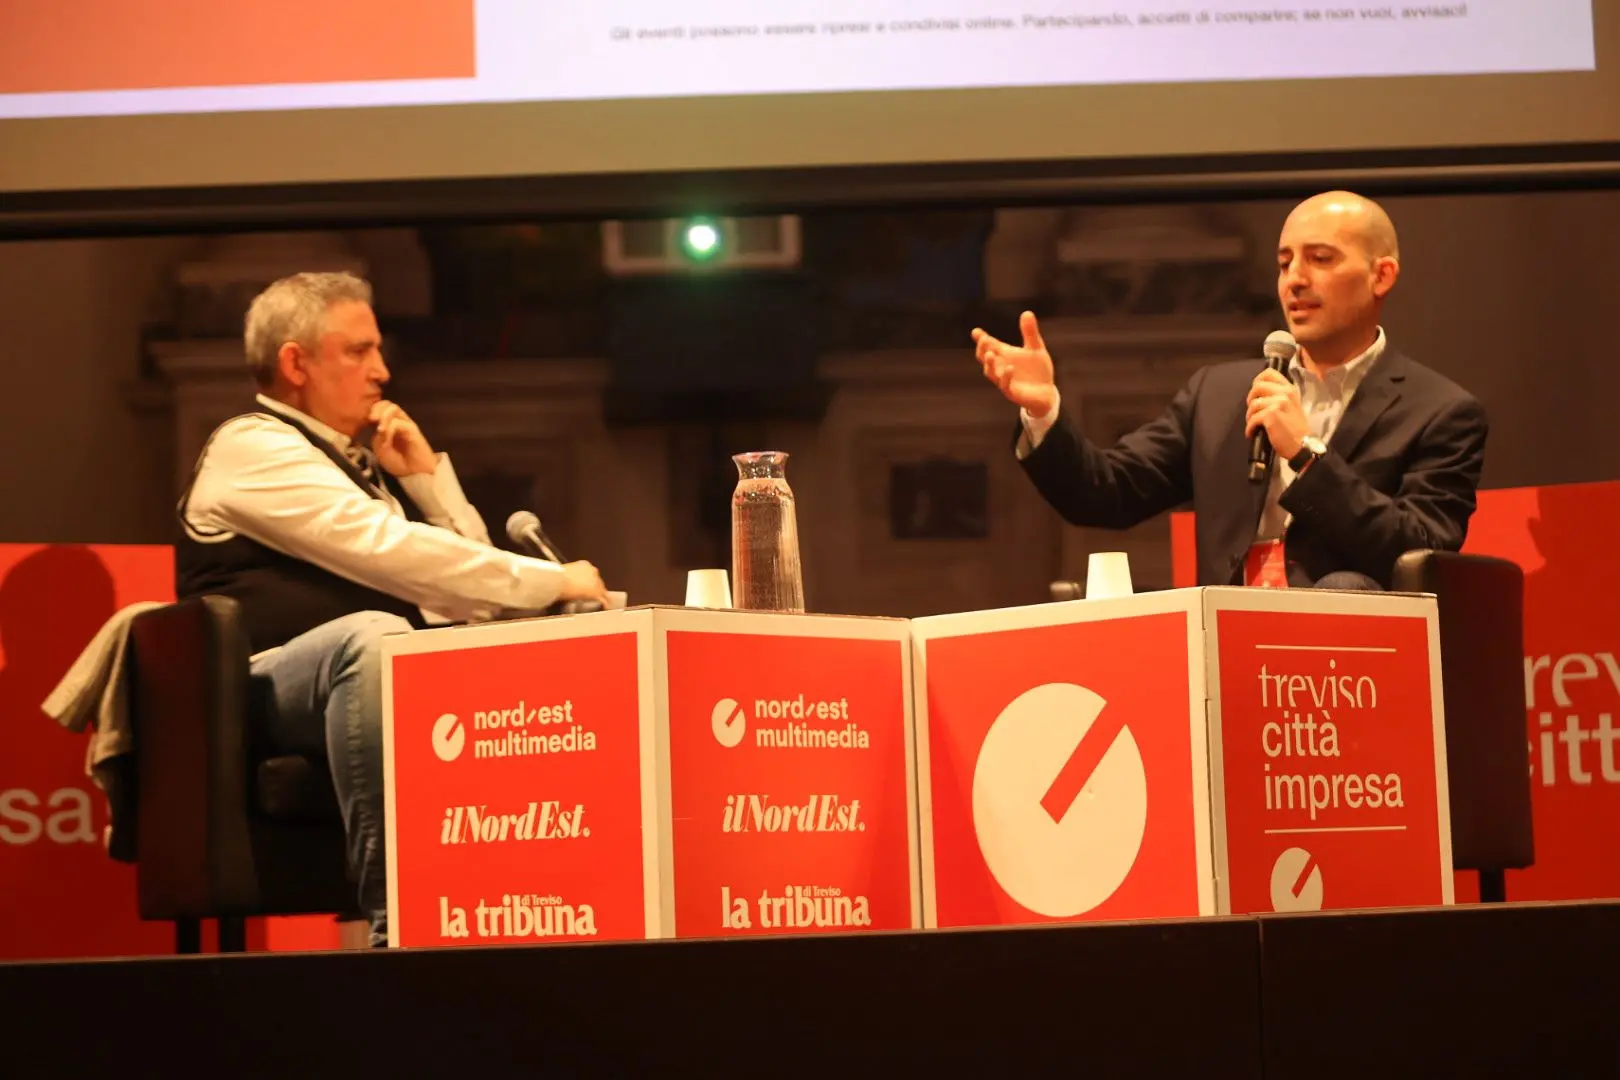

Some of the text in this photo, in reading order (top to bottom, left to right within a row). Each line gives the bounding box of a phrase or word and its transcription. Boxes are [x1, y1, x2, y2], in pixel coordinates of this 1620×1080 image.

[637, 27, 685, 39] eventi
[690, 25, 758, 39] possono
[764, 24, 816, 35] essere
[889, 18, 960, 31] condivisi
[1022, 13, 1133, 28] Partecipando,
[1138, 12, 1191, 25] accetti
[1196, 10, 1210, 24] di
[1303, 11, 1321, 20] se
[1326, 9, 1355, 20] non
[1258, 659, 1377, 708] treviso
[474, 726, 596, 758] multimedia
[756, 722, 870, 749] multimedia
[1261, 710, 1340, 757] città
[1528, 712, 1620, 786] itt
[1264, 763, 1404, 820] impresa
[0, 788, 97, 844] sa
[520, 894, 563, 906] di Treviso
[722, 885, 872, 928] la tribuna
[803, 886, 842, 897] di Treviso
[440, 894, 598, 937] la tribuna
